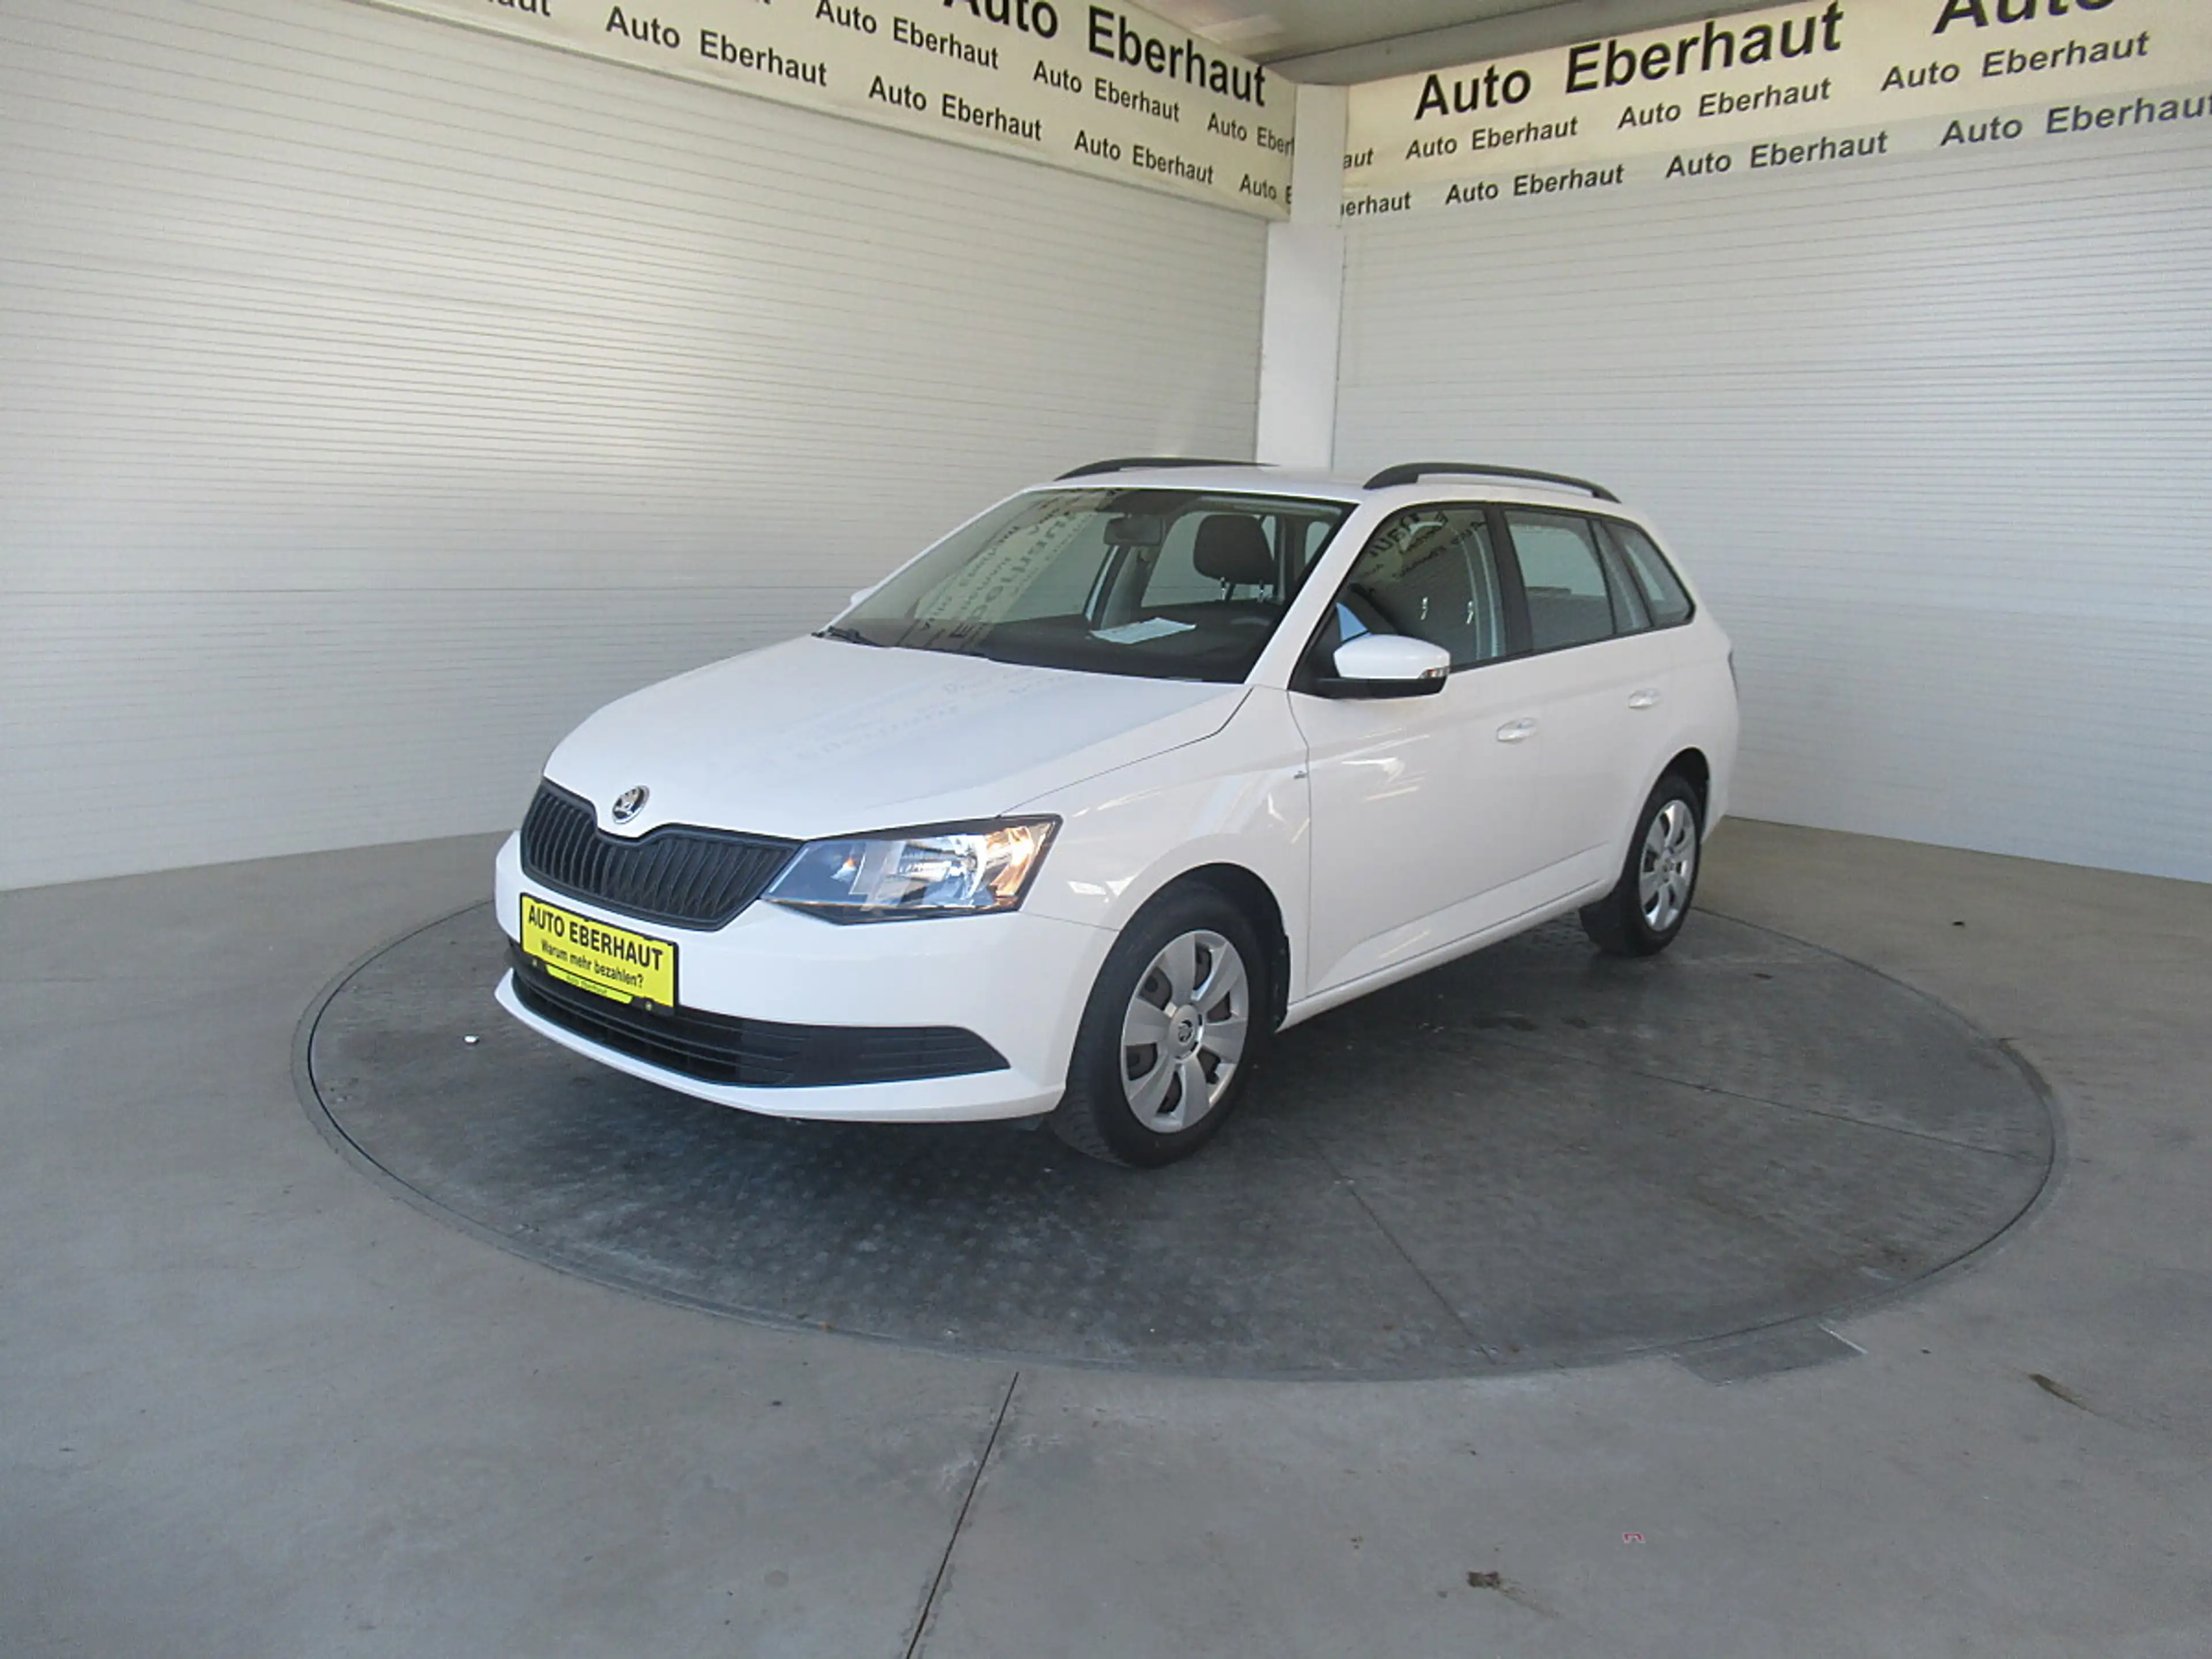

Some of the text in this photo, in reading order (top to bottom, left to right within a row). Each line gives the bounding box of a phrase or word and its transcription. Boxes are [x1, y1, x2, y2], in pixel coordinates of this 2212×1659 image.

[606, 6, 680, 48] Auto
[700, 29, 827, 87] Eberhaut
[869, 75, 927, 111] Auto
[942, 93, 1041, 142] Eberhaut
[1074, 130, 1121, 161] Auto
[1132, 145, 1213, 185] Eberhaut
[1239, 173, 1277, 200] Auto
[815, 0, 877, 34] Auto
[893, 16, 999, 69] Eberhaut
[1033, 60, 1082, 93] Auto
[1094, 77, 1179, 123] Eberhaut
[1207, 112, 1247, 141] Auto
[1089, 6, 1265, 107] Eberhaut
[1405, 137, 1457, 160] Auto
[1472, 116, 1578, 150] Eberhaut
[1618, 103, 1681, 129] Auto
[1698, 78, 1831, 117] Eberhaut
[1880, 62, 1960, 92] Auto
[1982, 31, 2149, 78] Eberhaut
[1414, 64, 1531, 120] Auto
[1566, 0, 1843, 93] Eberhaut
[1445, 181, 1498, 205] Auto
[1513, 164, 1624, 196] Eberhaut
[1665, 153, 1732, 179] Auto
[1750, 131, 1888, 169] Eberhaut
[1940, 116, 2022, 146] Auto
[529, 904, 663, 971] AUTO EBERHAUT
